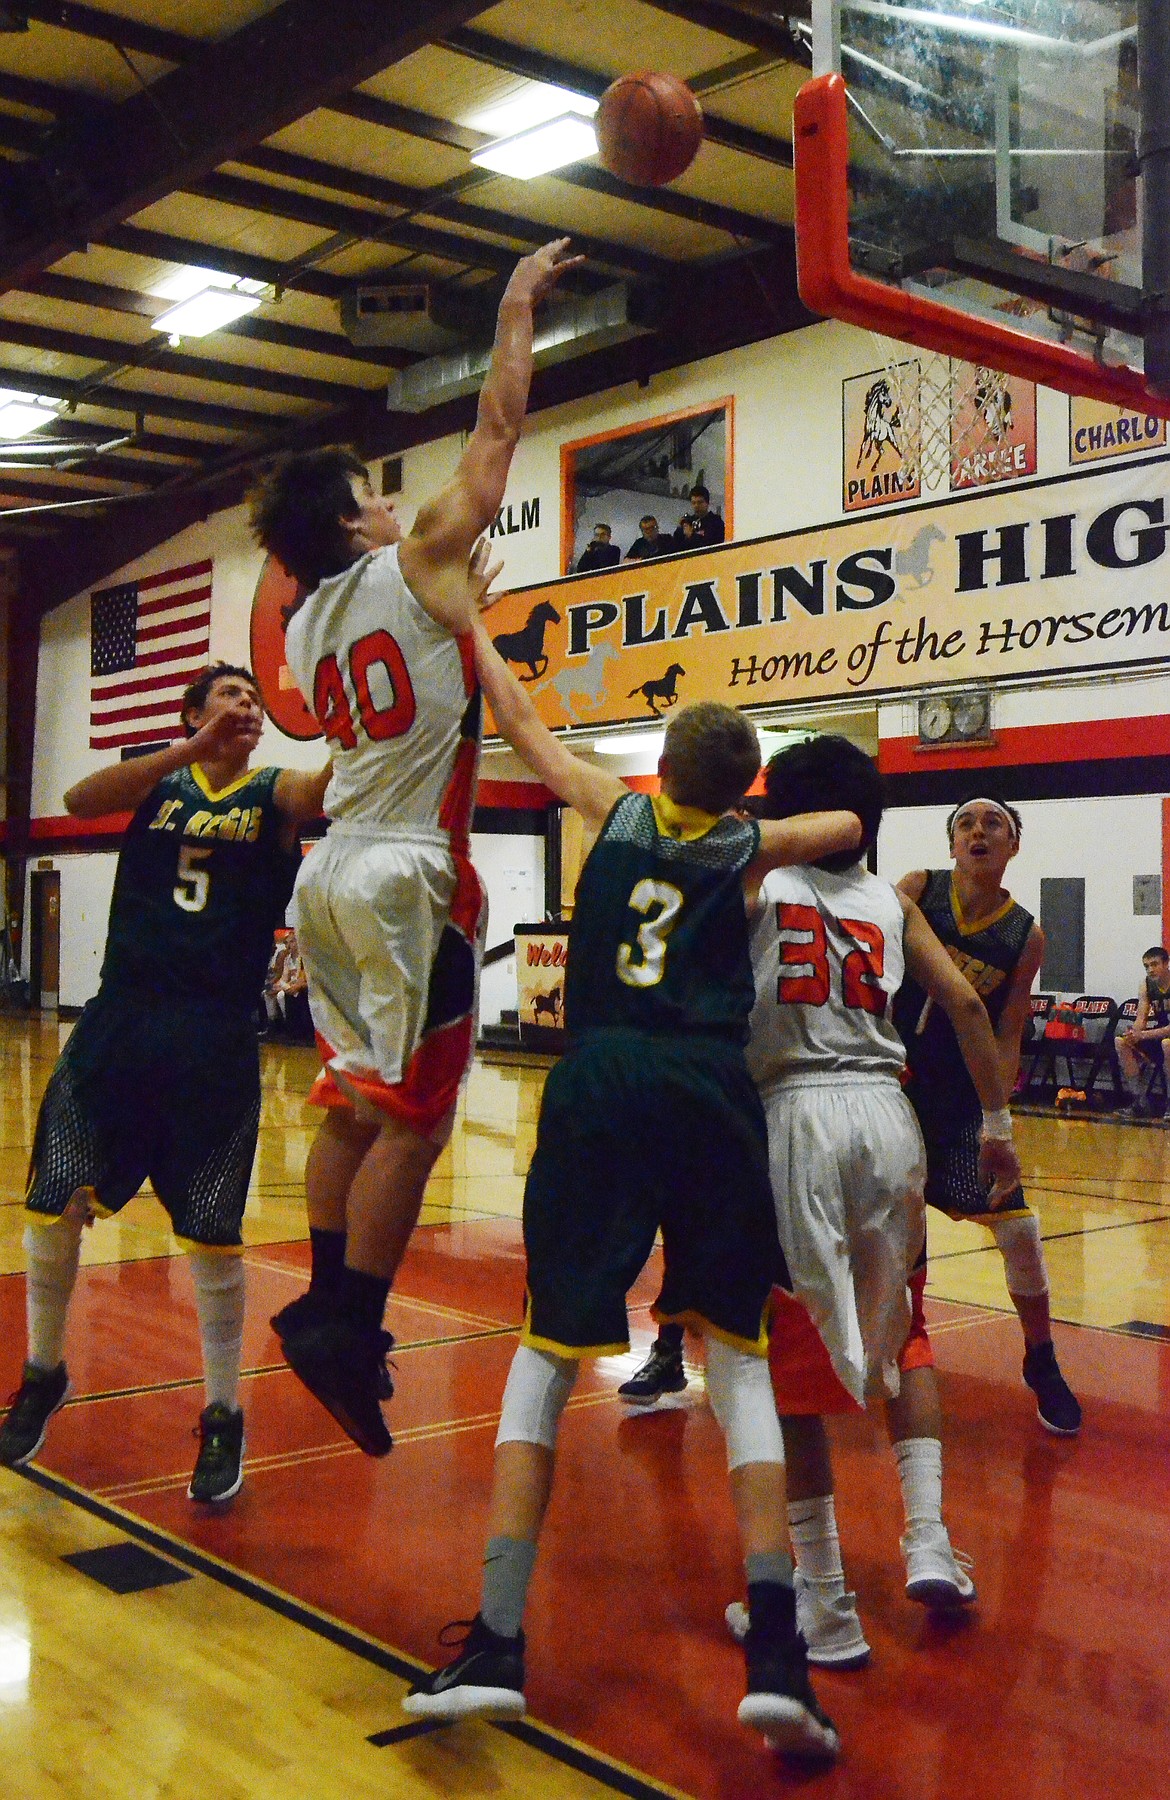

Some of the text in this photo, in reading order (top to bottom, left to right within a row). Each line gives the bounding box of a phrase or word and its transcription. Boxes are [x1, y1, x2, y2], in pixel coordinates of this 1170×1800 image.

[1075, 416, 1159, 454] CHARLO
[489, 497, 540, 539] KLM
[567, 497, 1170, 656] PLAINS HIG
[727, 602, 1170, 687] Home of the Horsem
[313, 628, 416, 751] 40
[183, 806, 263, 842] REGIS
[173, 844, 215, 913] 5
[616, 878, 684, 988] 3
[777, 901, 889, 1018] 32
